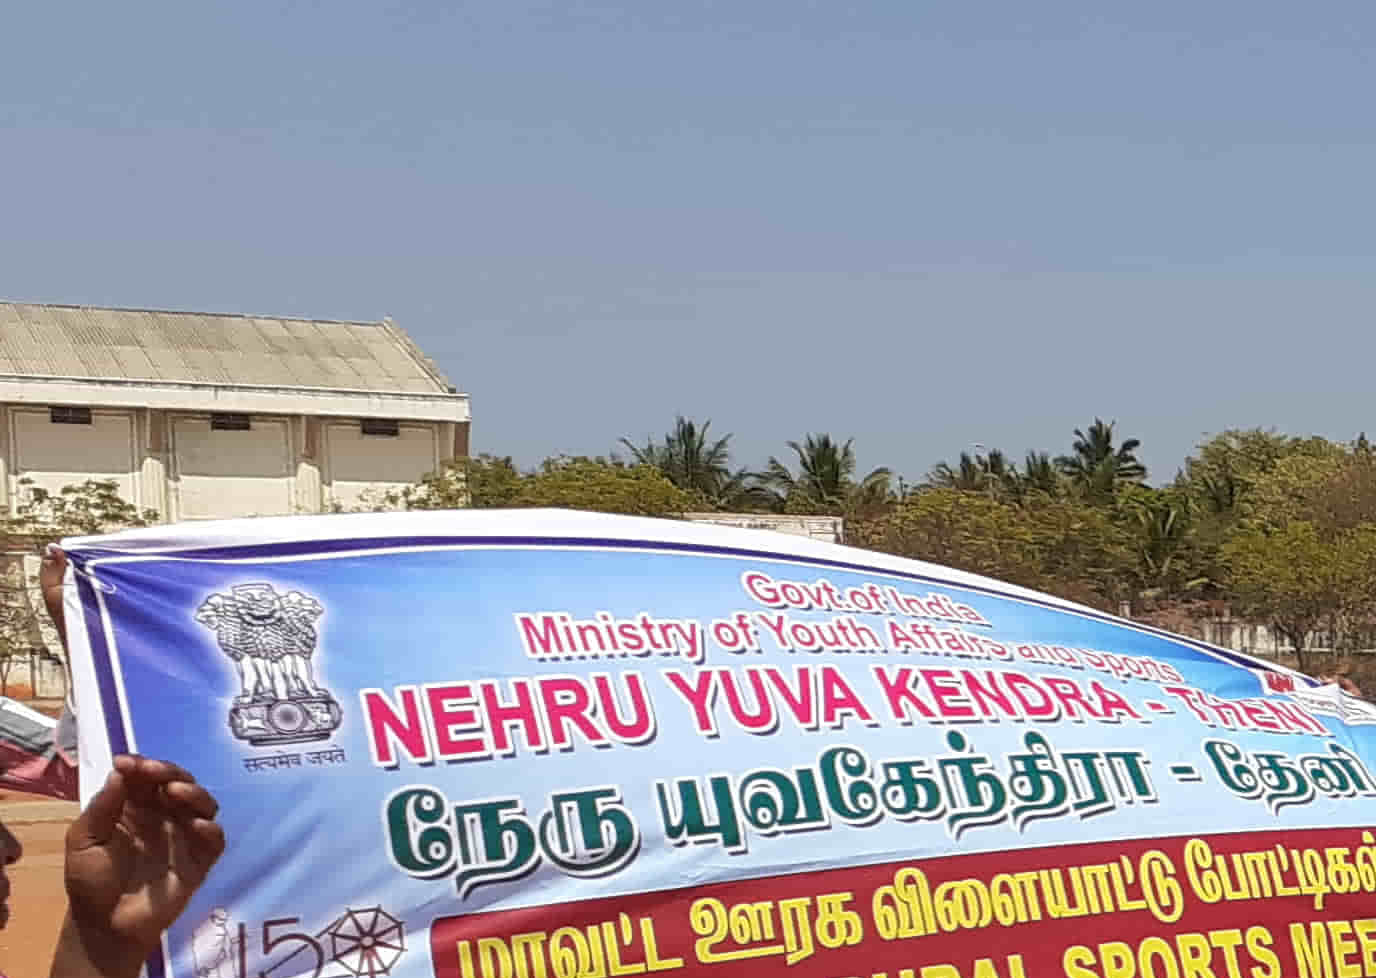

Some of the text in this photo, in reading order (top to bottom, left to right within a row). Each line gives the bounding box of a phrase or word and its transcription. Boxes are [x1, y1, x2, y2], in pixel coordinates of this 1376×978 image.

[519, 614, 704, 661] Ministry
[713, 613, 755, 650] of
[760, 614, 880, 651] Youth
[888, 622, 1008, 658] Affairs
[891, 589, 986, 622] India
[364, 672, 654, 764] NEHRU
[666, 666, 874, 734] YUVA
[875, 667, 1140, 720] KENDRA
[386, 786, 637, 894] நேரு
[655, 730, 1154, 846] யுவகேந்திரா
[1203, 738, 1376, 808] தேனி
[690, 891, 863, 965] ஊரக
[872, 849, 1184, 940] விளையாட்டு
